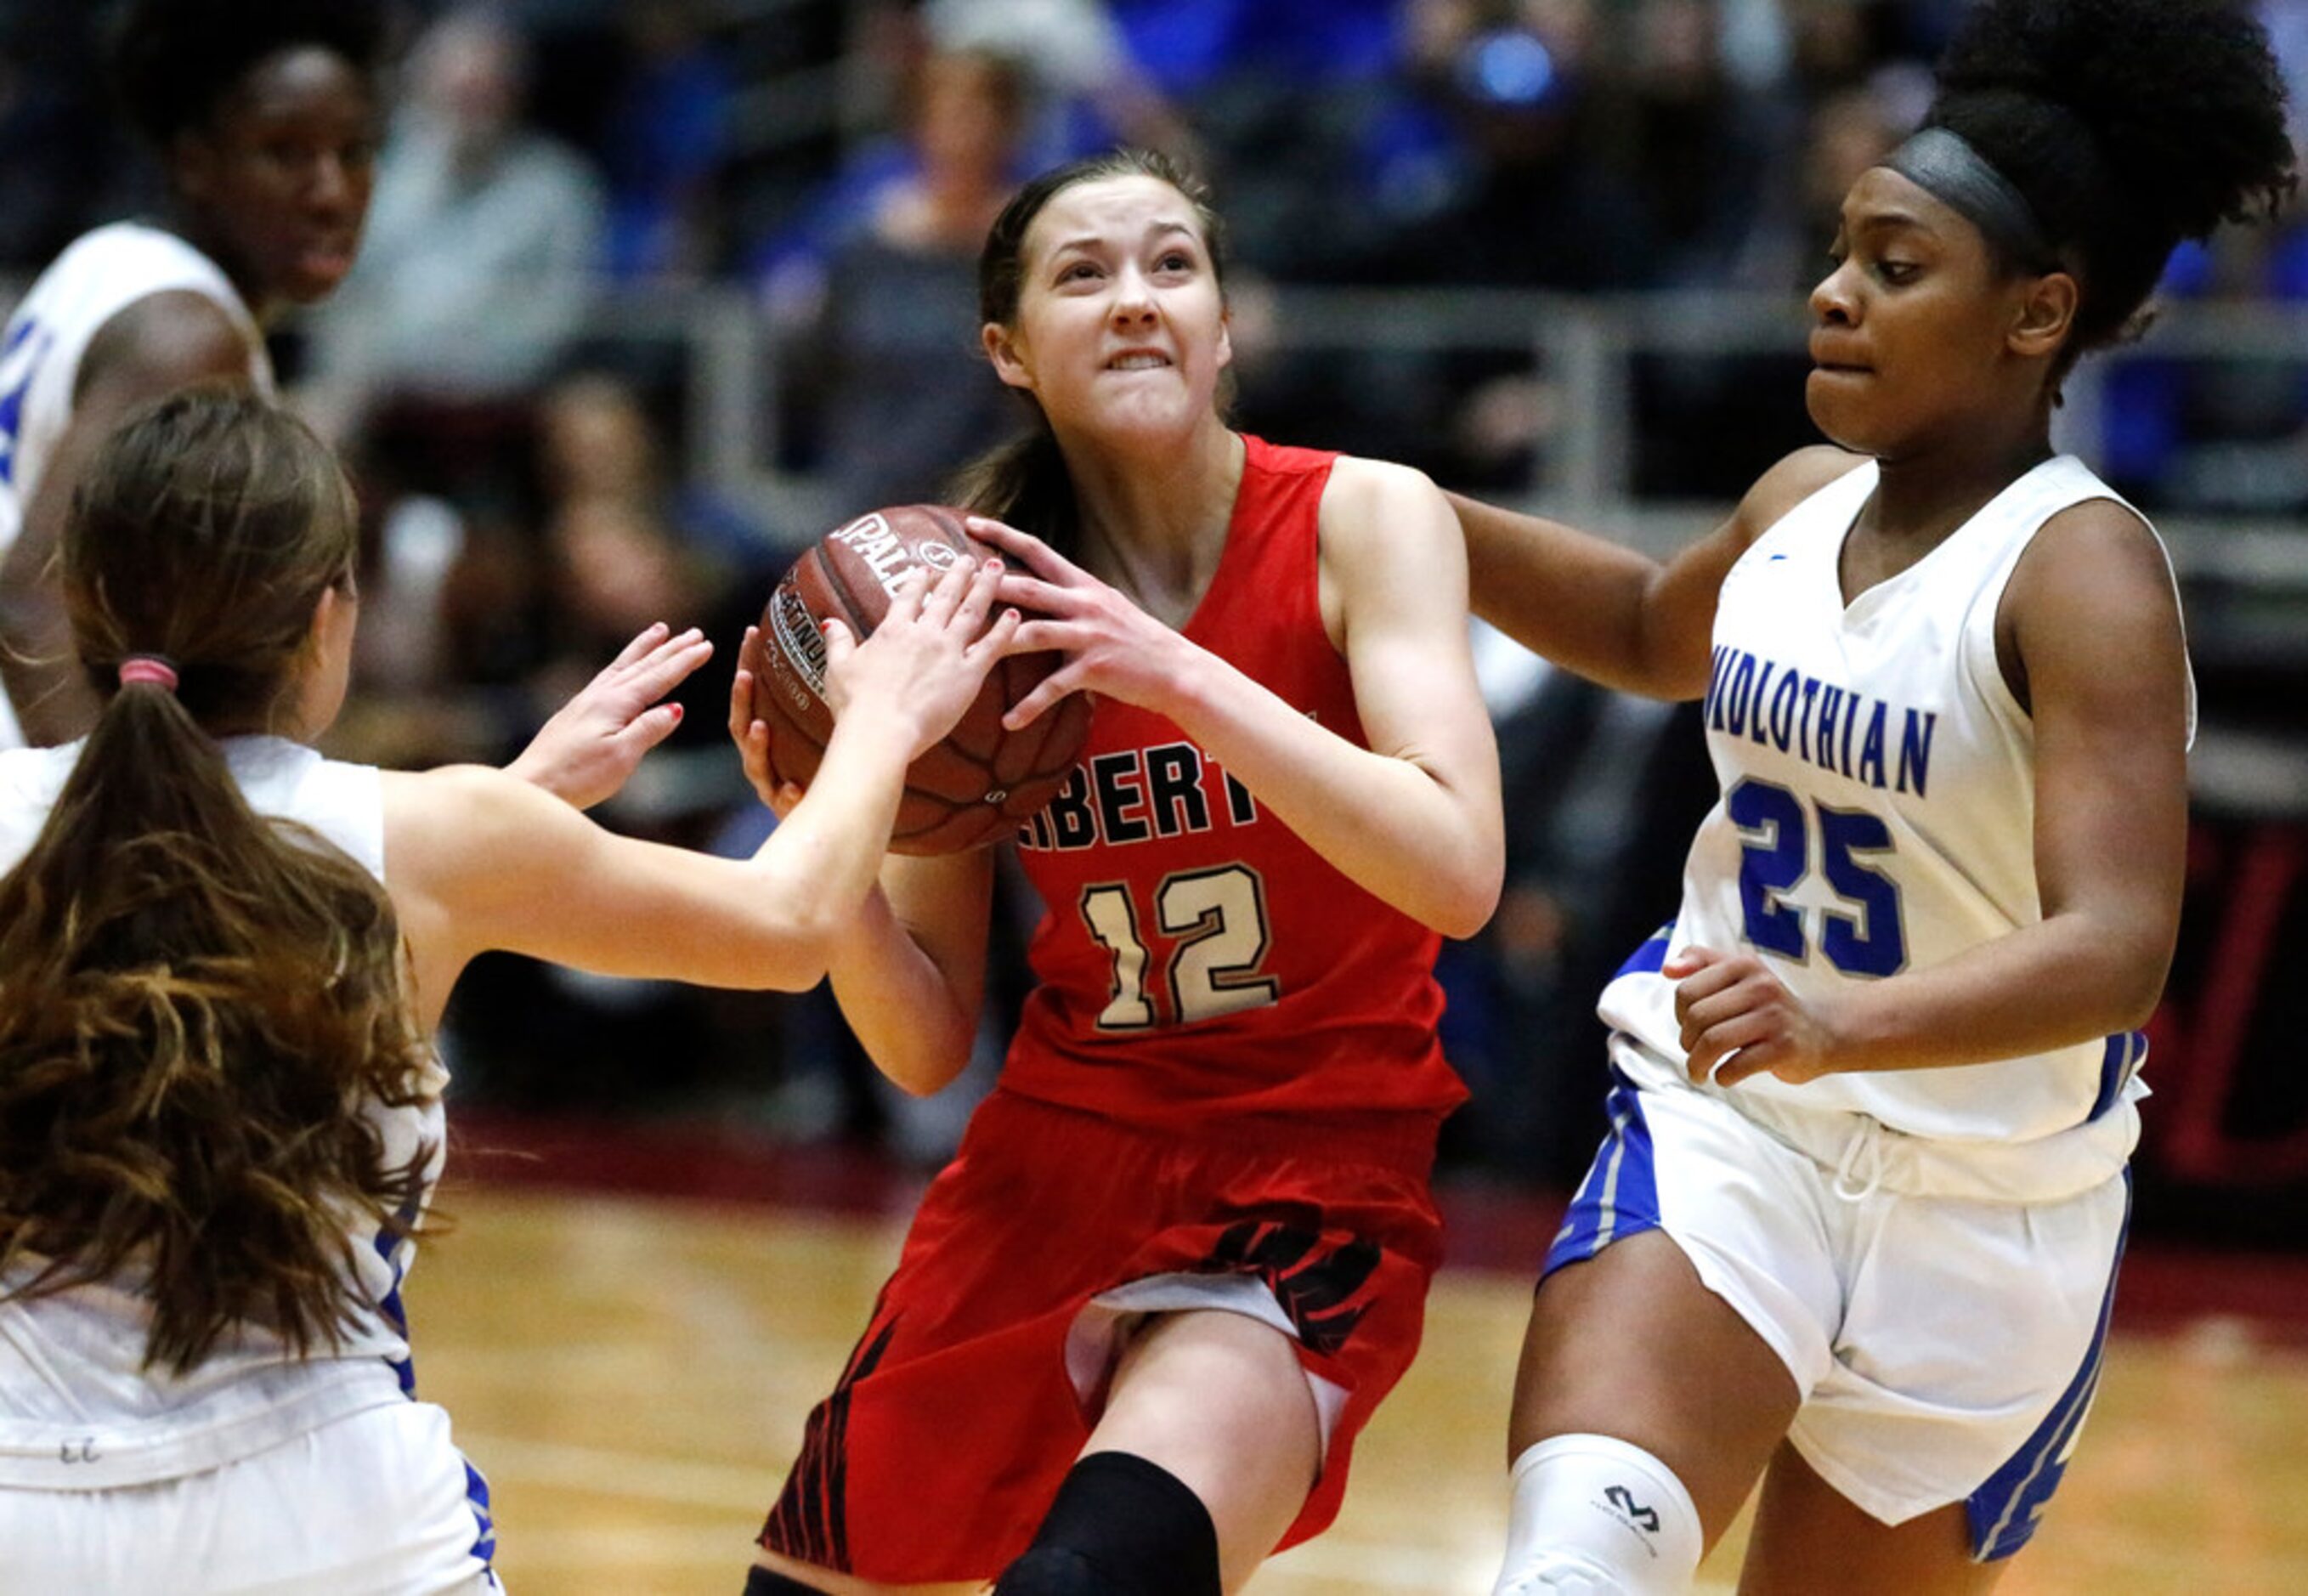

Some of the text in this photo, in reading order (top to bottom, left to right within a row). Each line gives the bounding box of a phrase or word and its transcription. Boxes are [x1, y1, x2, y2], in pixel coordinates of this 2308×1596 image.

[829, 512, 919, 599] SPAL
[1079, 860, 1280, 1032] 12
[1725, 773, 1911, 979] 25
